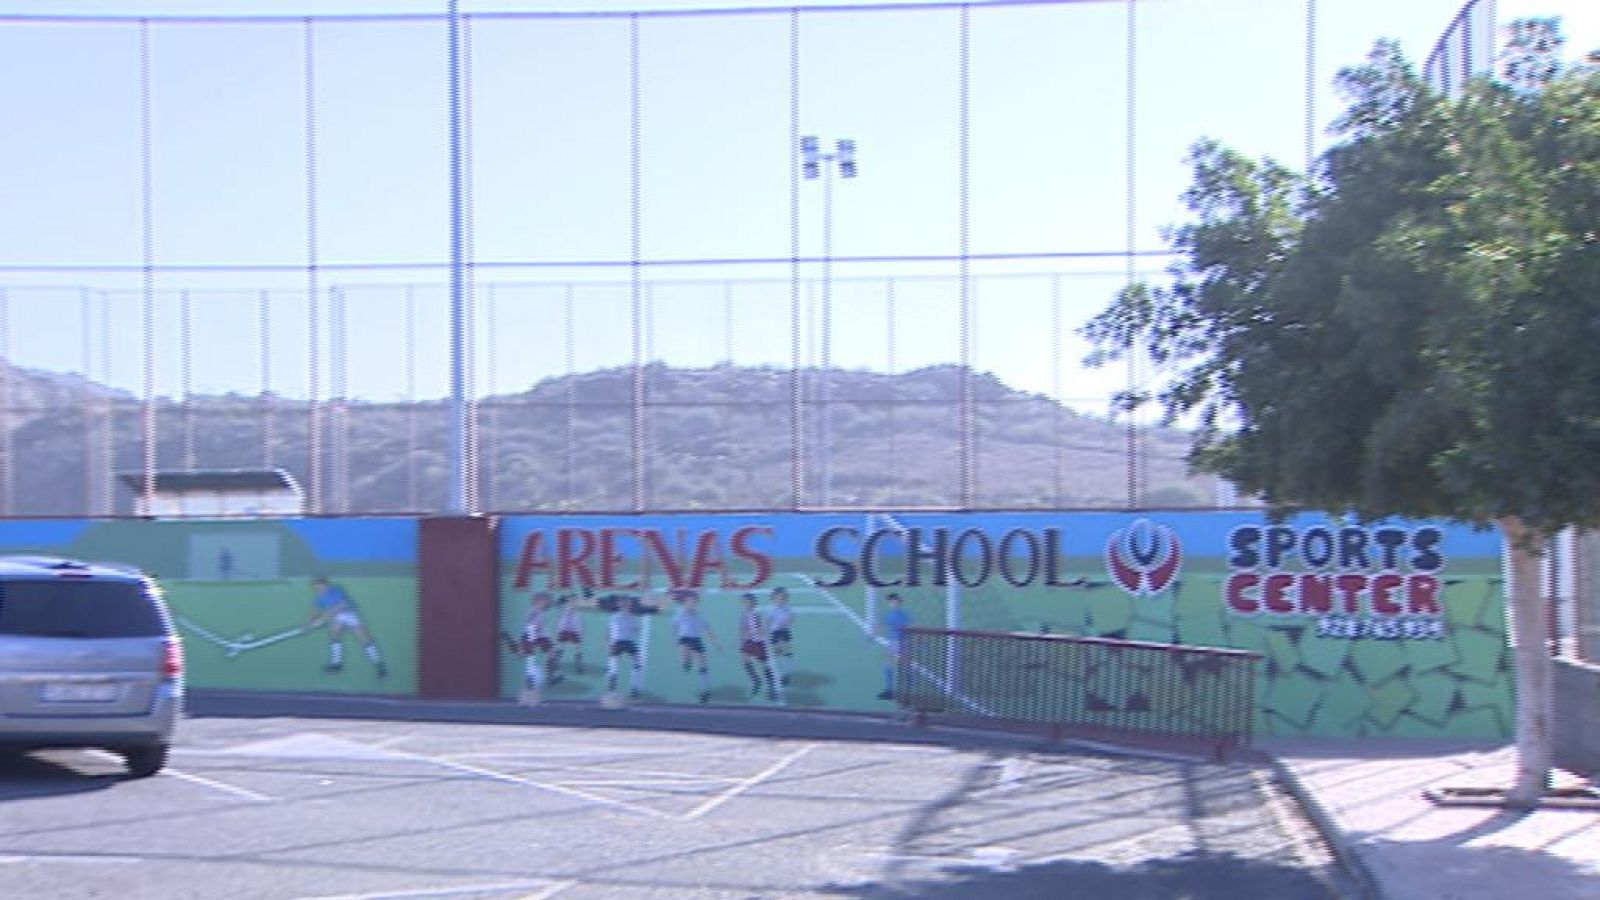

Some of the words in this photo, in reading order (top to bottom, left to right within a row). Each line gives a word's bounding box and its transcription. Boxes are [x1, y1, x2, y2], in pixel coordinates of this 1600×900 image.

[512, 525, 775, 590] ARENAS
[813, 526, 1086, 588] SCHOOL
[1227, 525, 1446, 571] SPORTS
[1225, 573, 1442, 615] CENTER
